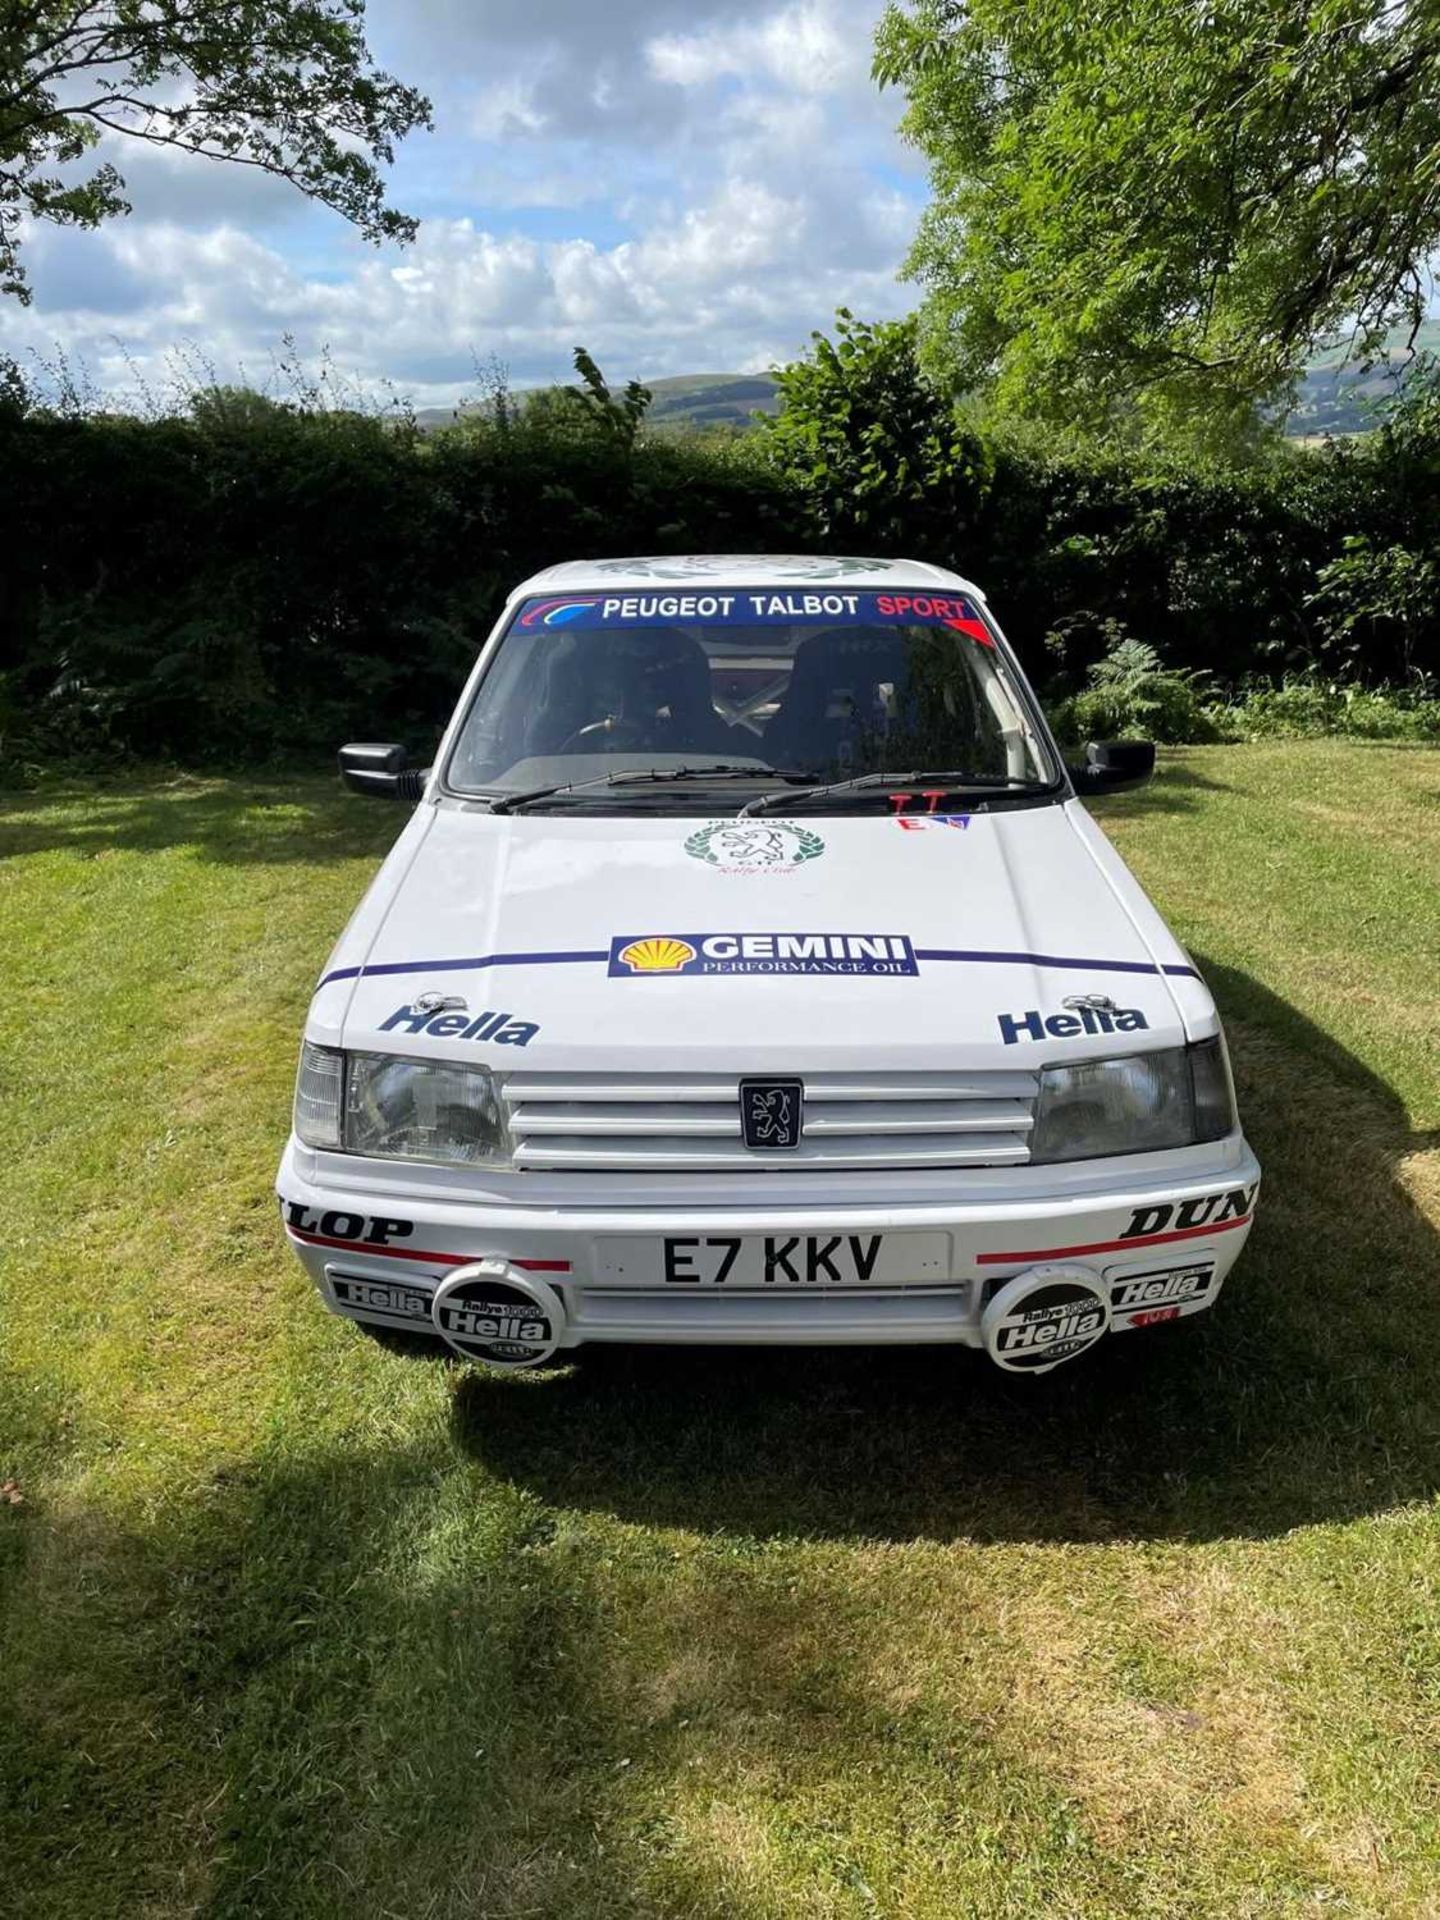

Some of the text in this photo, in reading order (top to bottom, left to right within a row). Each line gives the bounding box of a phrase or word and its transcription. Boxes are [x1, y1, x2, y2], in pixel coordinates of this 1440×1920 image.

[602, 595, 965, 619] PEUGEOT TALBOT SPORT
[701, 935, 907, 961] GEMINI
[703, 962, 911, 974] PERFORMANCE OIL
[377, 1004, 541, 1047] Hella
[997, 1007, 1150, 1045] Hella
[278, 1195, 414, 1246] LOP
[1118, 1181, 1259, 1240] DUN
[664, 1235, 883, 1283] E7 KKV
[348, 1283, 426, 1314] Hella
[1120, 1276, 1200, 1304] Hella
[447, 1310, 545, 1341] Hella
[1003, 1312, 1101, 1350] Hella
